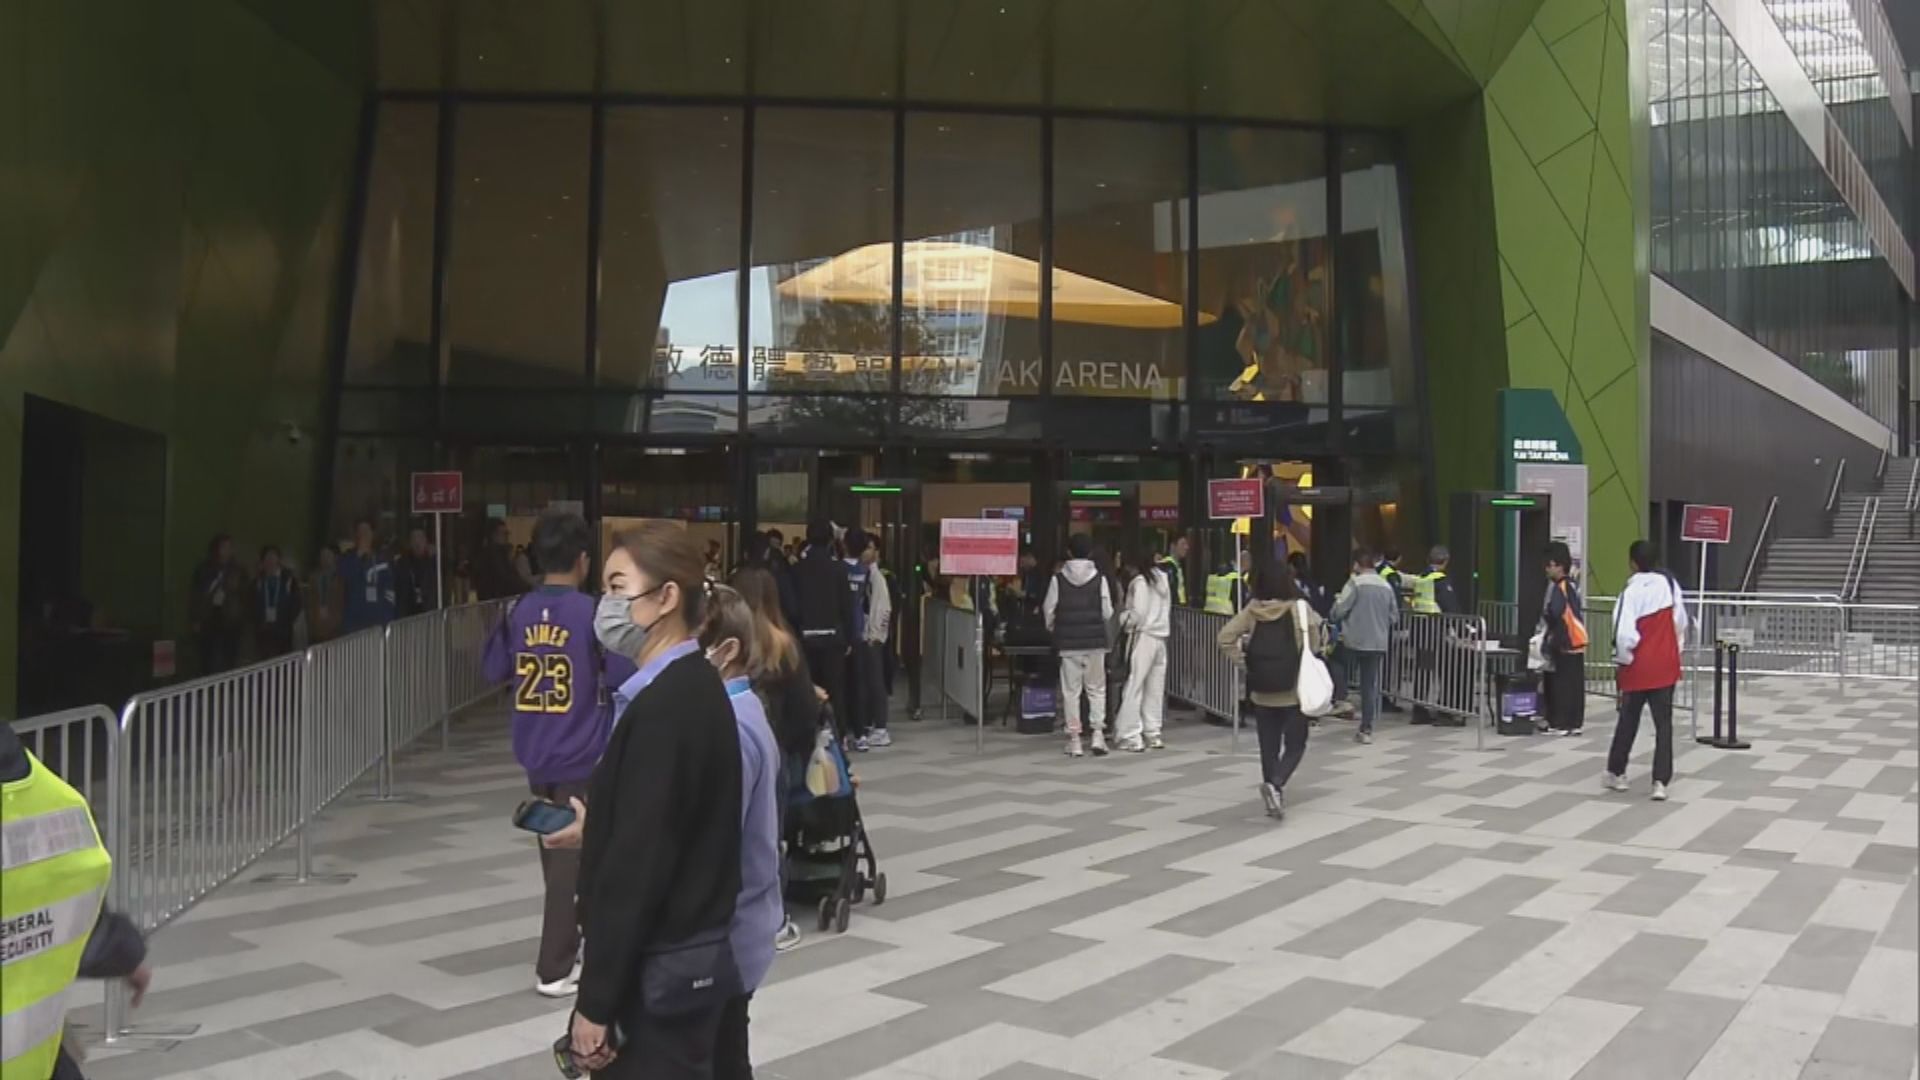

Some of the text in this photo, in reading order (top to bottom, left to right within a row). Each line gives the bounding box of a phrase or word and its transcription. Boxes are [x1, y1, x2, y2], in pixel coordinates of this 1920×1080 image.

[1055, 361, 1162, 389] ARENA
[525, 624, 569, 648] JAMES
[516, 652, 573, 713] 23
